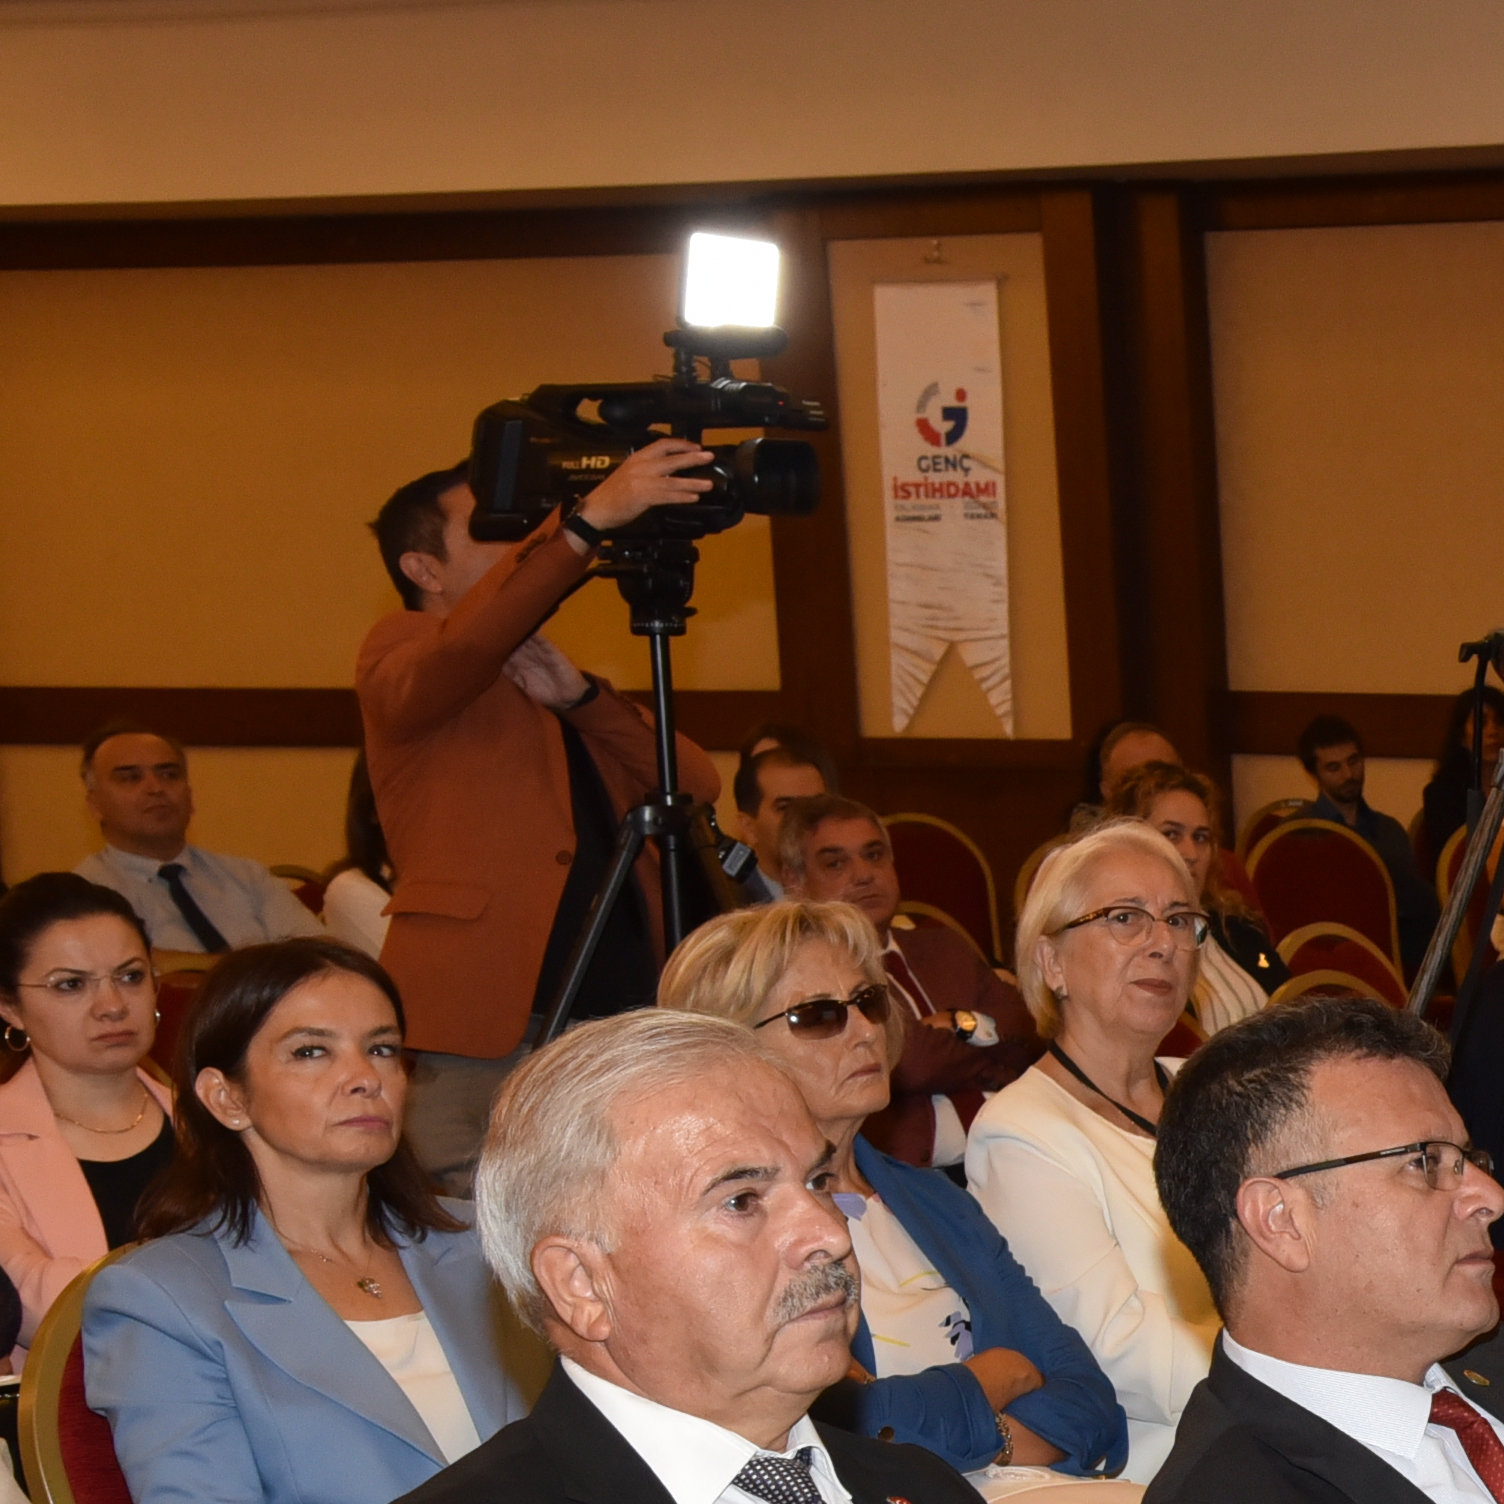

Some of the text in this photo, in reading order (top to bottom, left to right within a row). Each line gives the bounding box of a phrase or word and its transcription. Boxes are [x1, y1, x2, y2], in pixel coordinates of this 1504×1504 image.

[581, 455, 610, 469] HD
[917, 454, 971, 477] GENÇ
[893, 476, 997, 501] İSTİHDAMI
